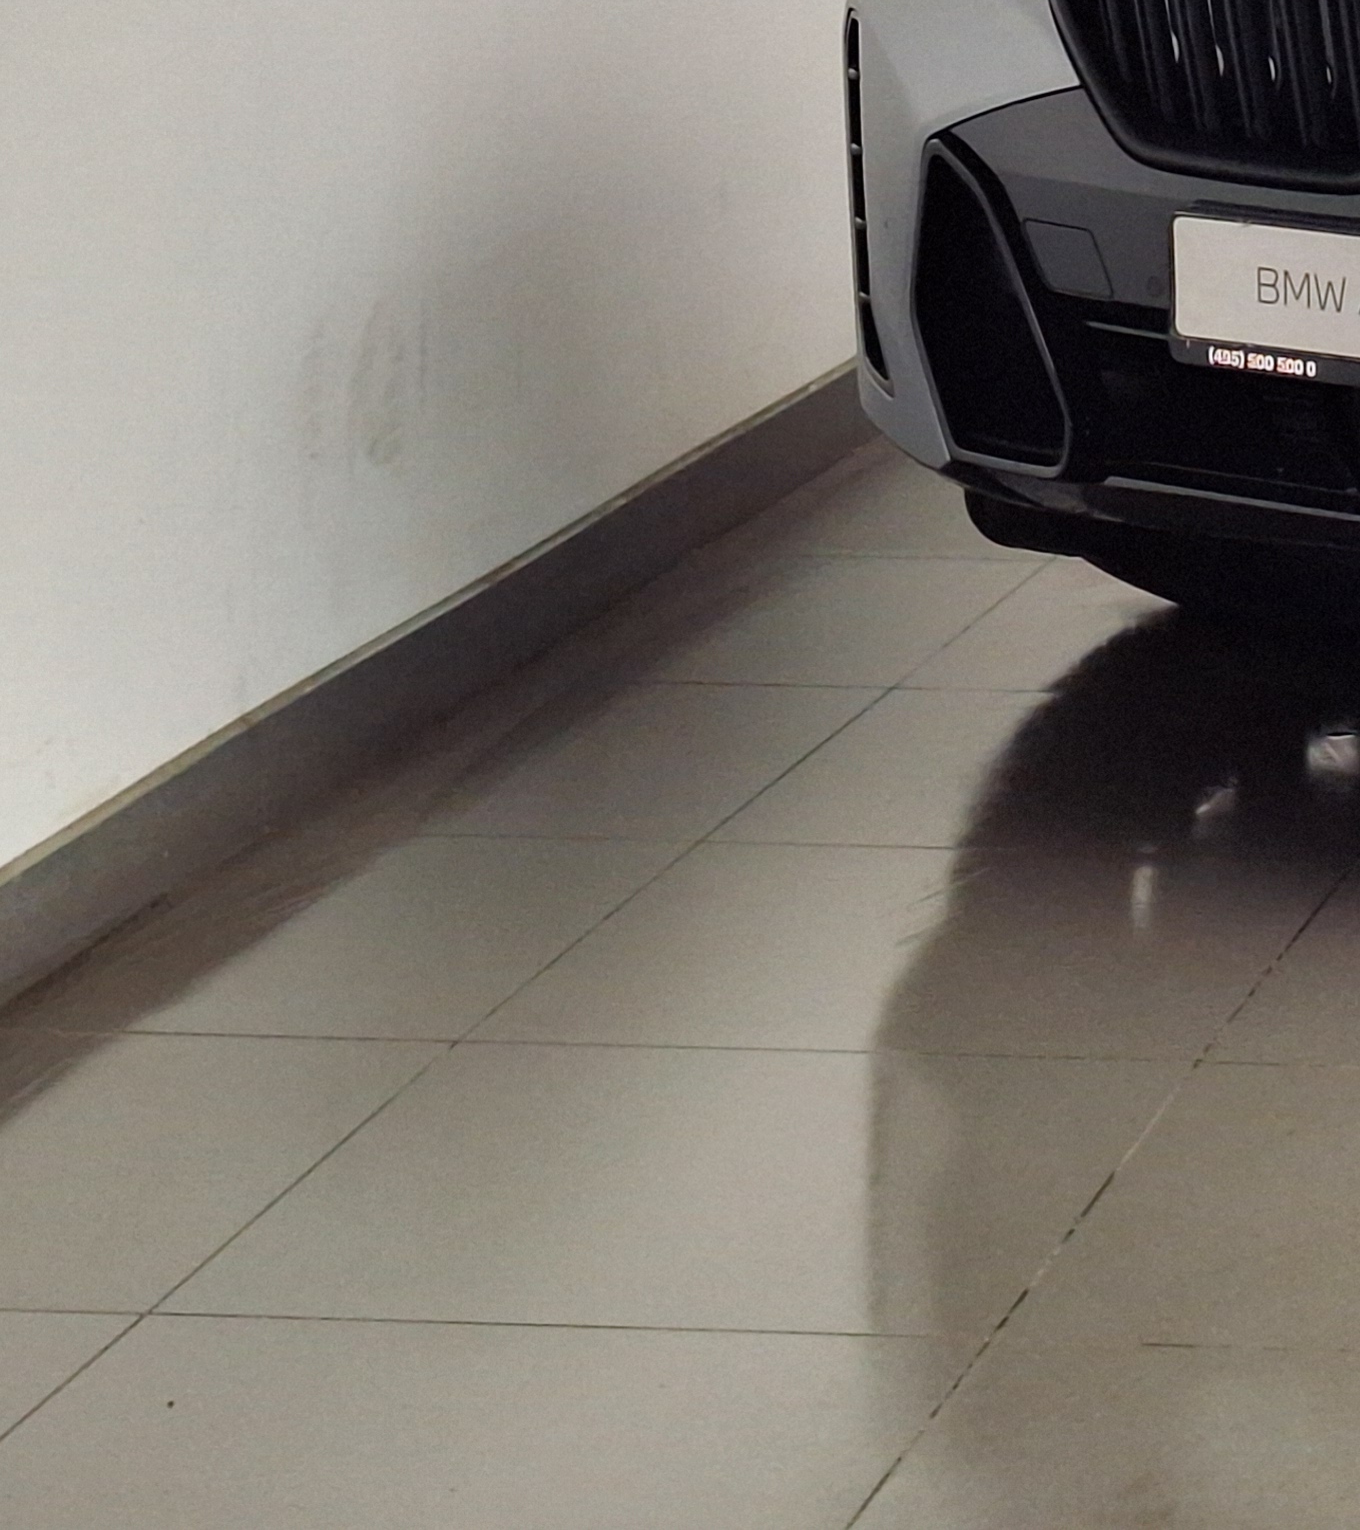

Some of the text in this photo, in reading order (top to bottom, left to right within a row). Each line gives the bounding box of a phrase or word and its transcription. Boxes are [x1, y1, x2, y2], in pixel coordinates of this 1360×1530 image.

[1256, 266, 1347, 314] BMW
[1247, 352, 1275, 372] 500
[1276, 356, 1304, 376] 500
